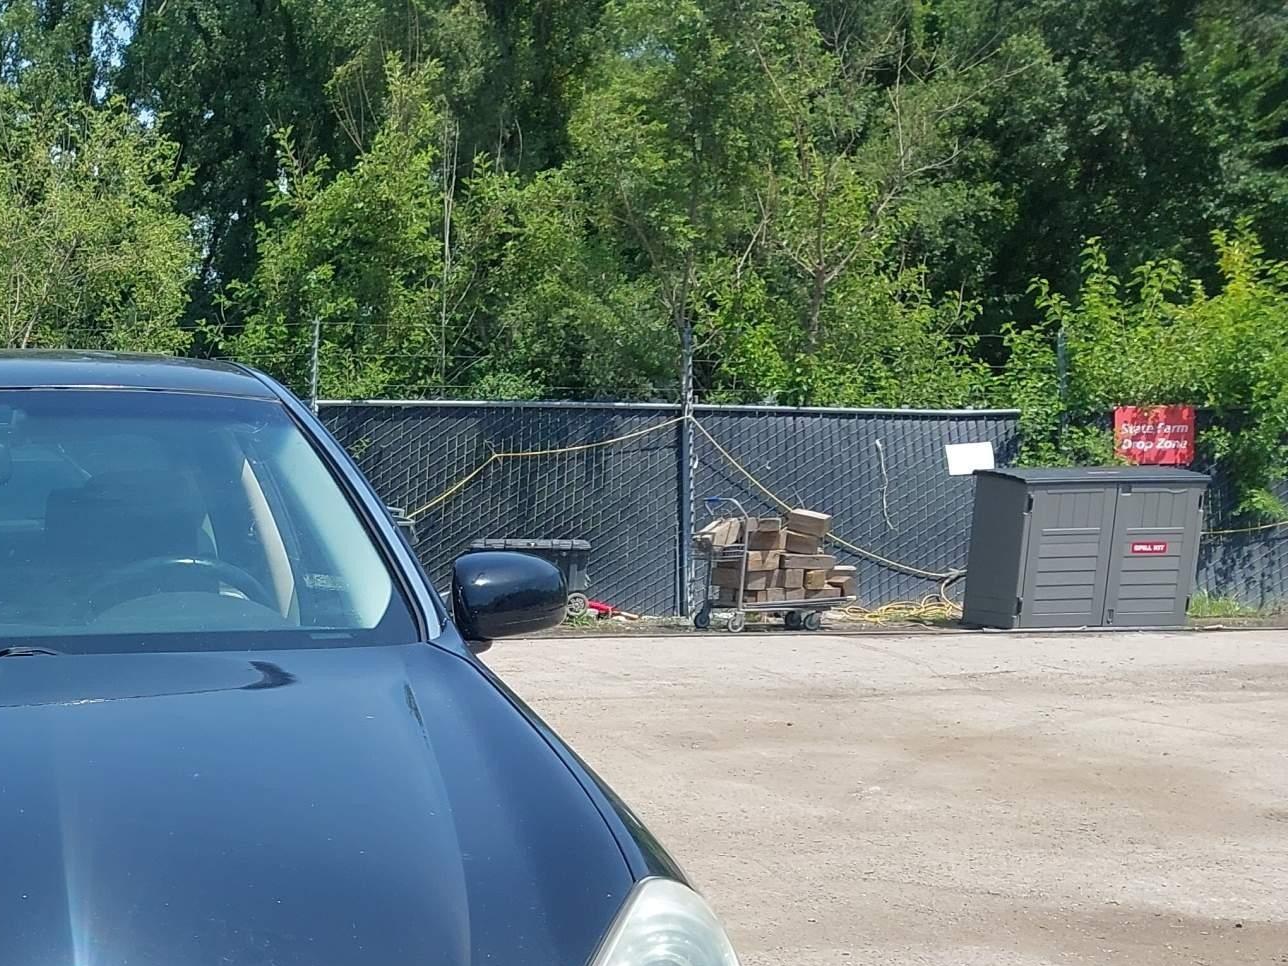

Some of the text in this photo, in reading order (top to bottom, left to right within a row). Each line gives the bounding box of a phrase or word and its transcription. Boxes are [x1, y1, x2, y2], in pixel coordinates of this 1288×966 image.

[1121, 422, 1188, 434] State Farm
[1121, 437, 1188, 451] Drop Zone
